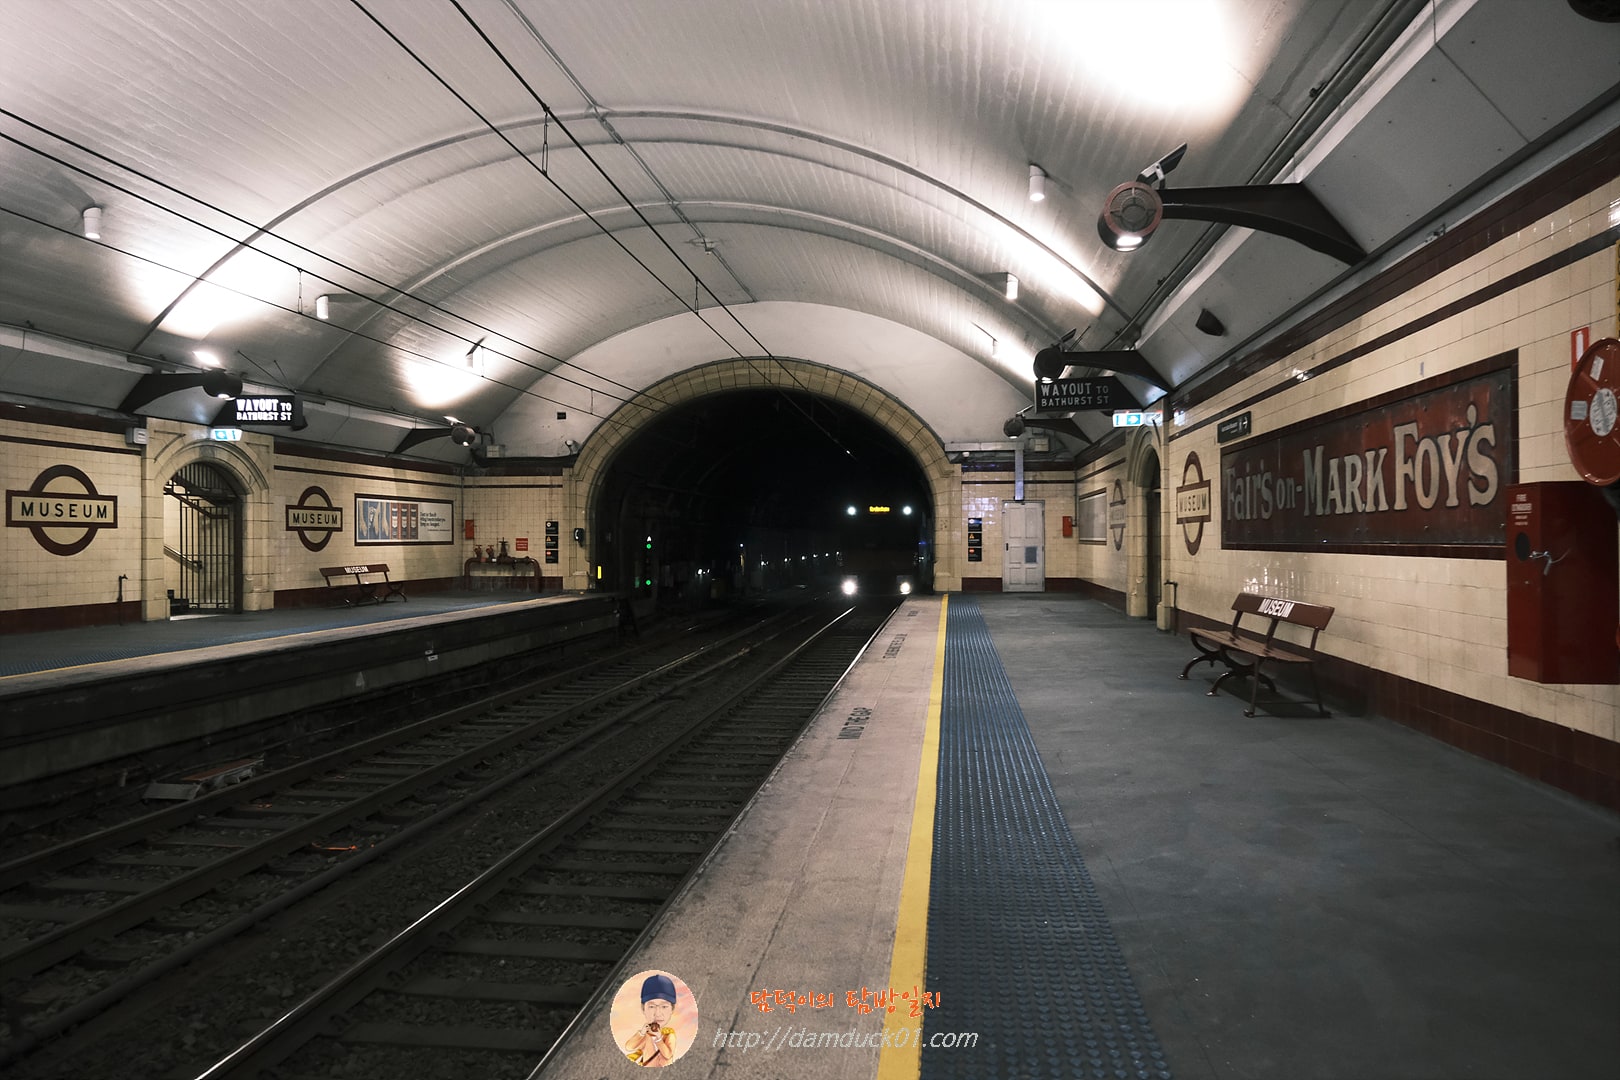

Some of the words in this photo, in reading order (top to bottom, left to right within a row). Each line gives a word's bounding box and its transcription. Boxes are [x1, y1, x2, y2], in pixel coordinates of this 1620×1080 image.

[1096, 386, 1109, 394] TO
[280, 402, 292, 411] TO
[1041, 397, 1093, 407] BATHURST
[1097, 396, 1109, 404] ST
[236, 411, 279, 421] BATHURST
[280, 411, 292, 421] ST
[1226, 459, 1273, 521] Fair's
[1303, 446, 1389, 517] MARK
[1394, 404, 1499, 512] FOY'S
[1179, 493, 1206, 513] MUSEUM
[21, 501, 107, 519] MUSEUM
[292, 512, 338, 525] MUSEUM
[344, 566, 369, 574] MUSEUM
[1258, 598, 1295, 618] MUSEUM
